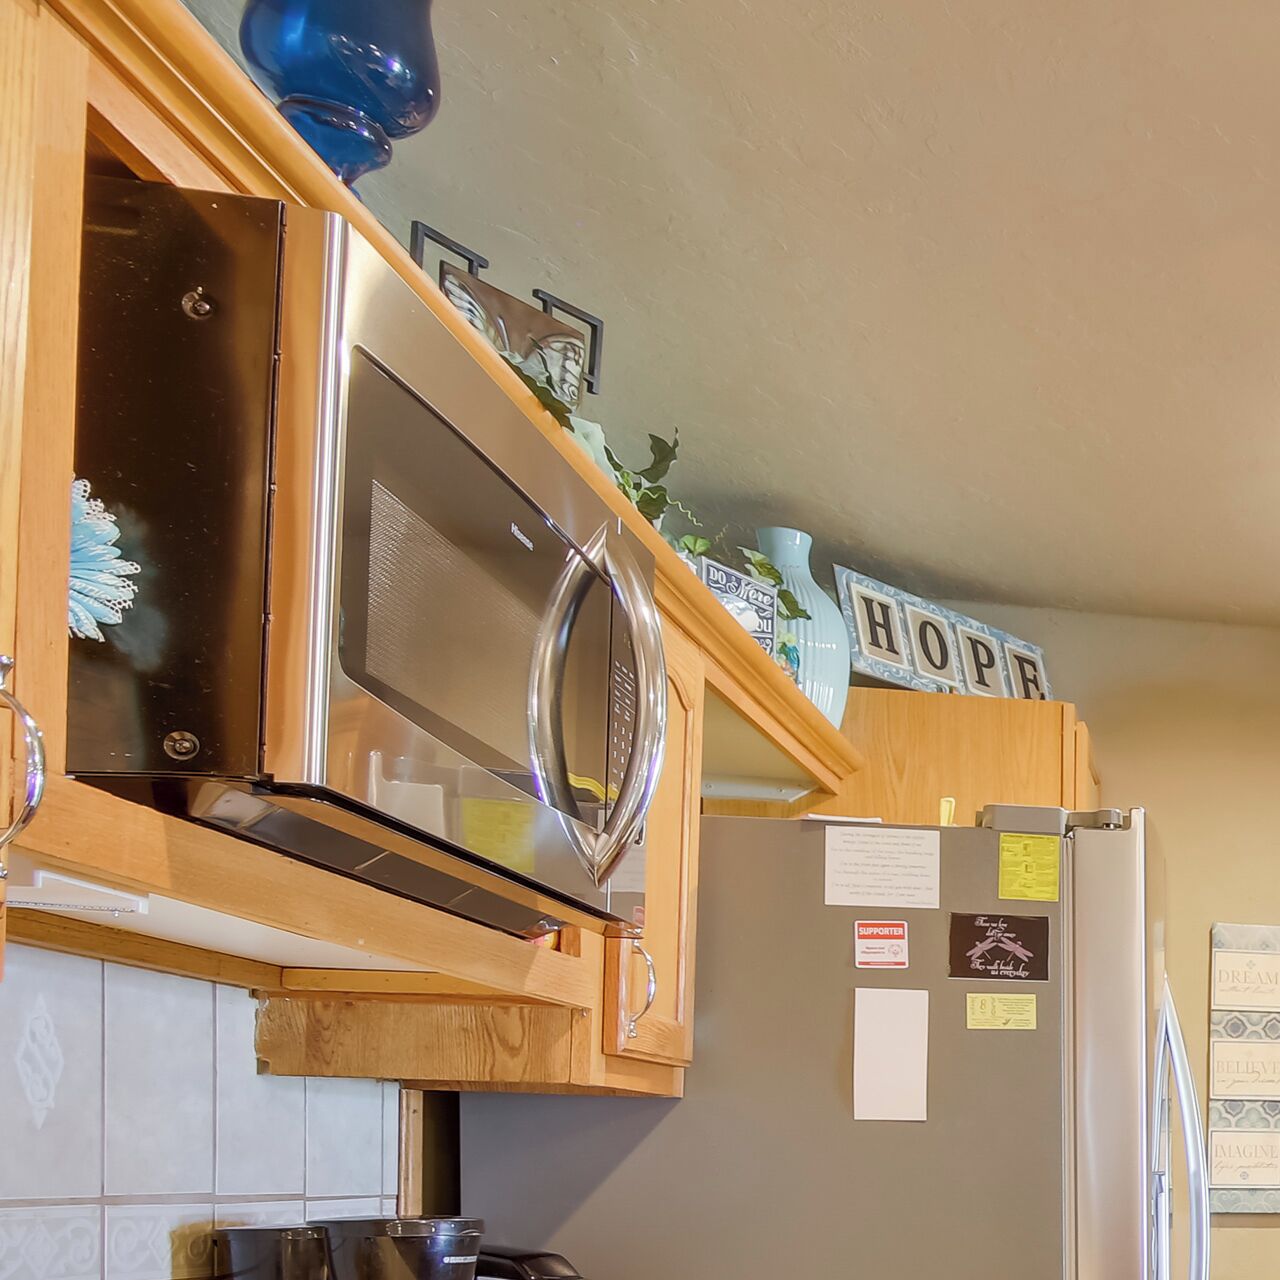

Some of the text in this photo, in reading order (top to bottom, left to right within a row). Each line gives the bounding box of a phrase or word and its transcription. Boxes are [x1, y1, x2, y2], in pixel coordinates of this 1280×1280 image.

[709, 566, 727, 584] DO
[860, 595, 1046, 700] HOPE
[858, 926, 904, 936] SUPPORTER
[1219, 969, 1279, 985] DREAM
[1214, 1144, 1279, 1159] IMAGINE
